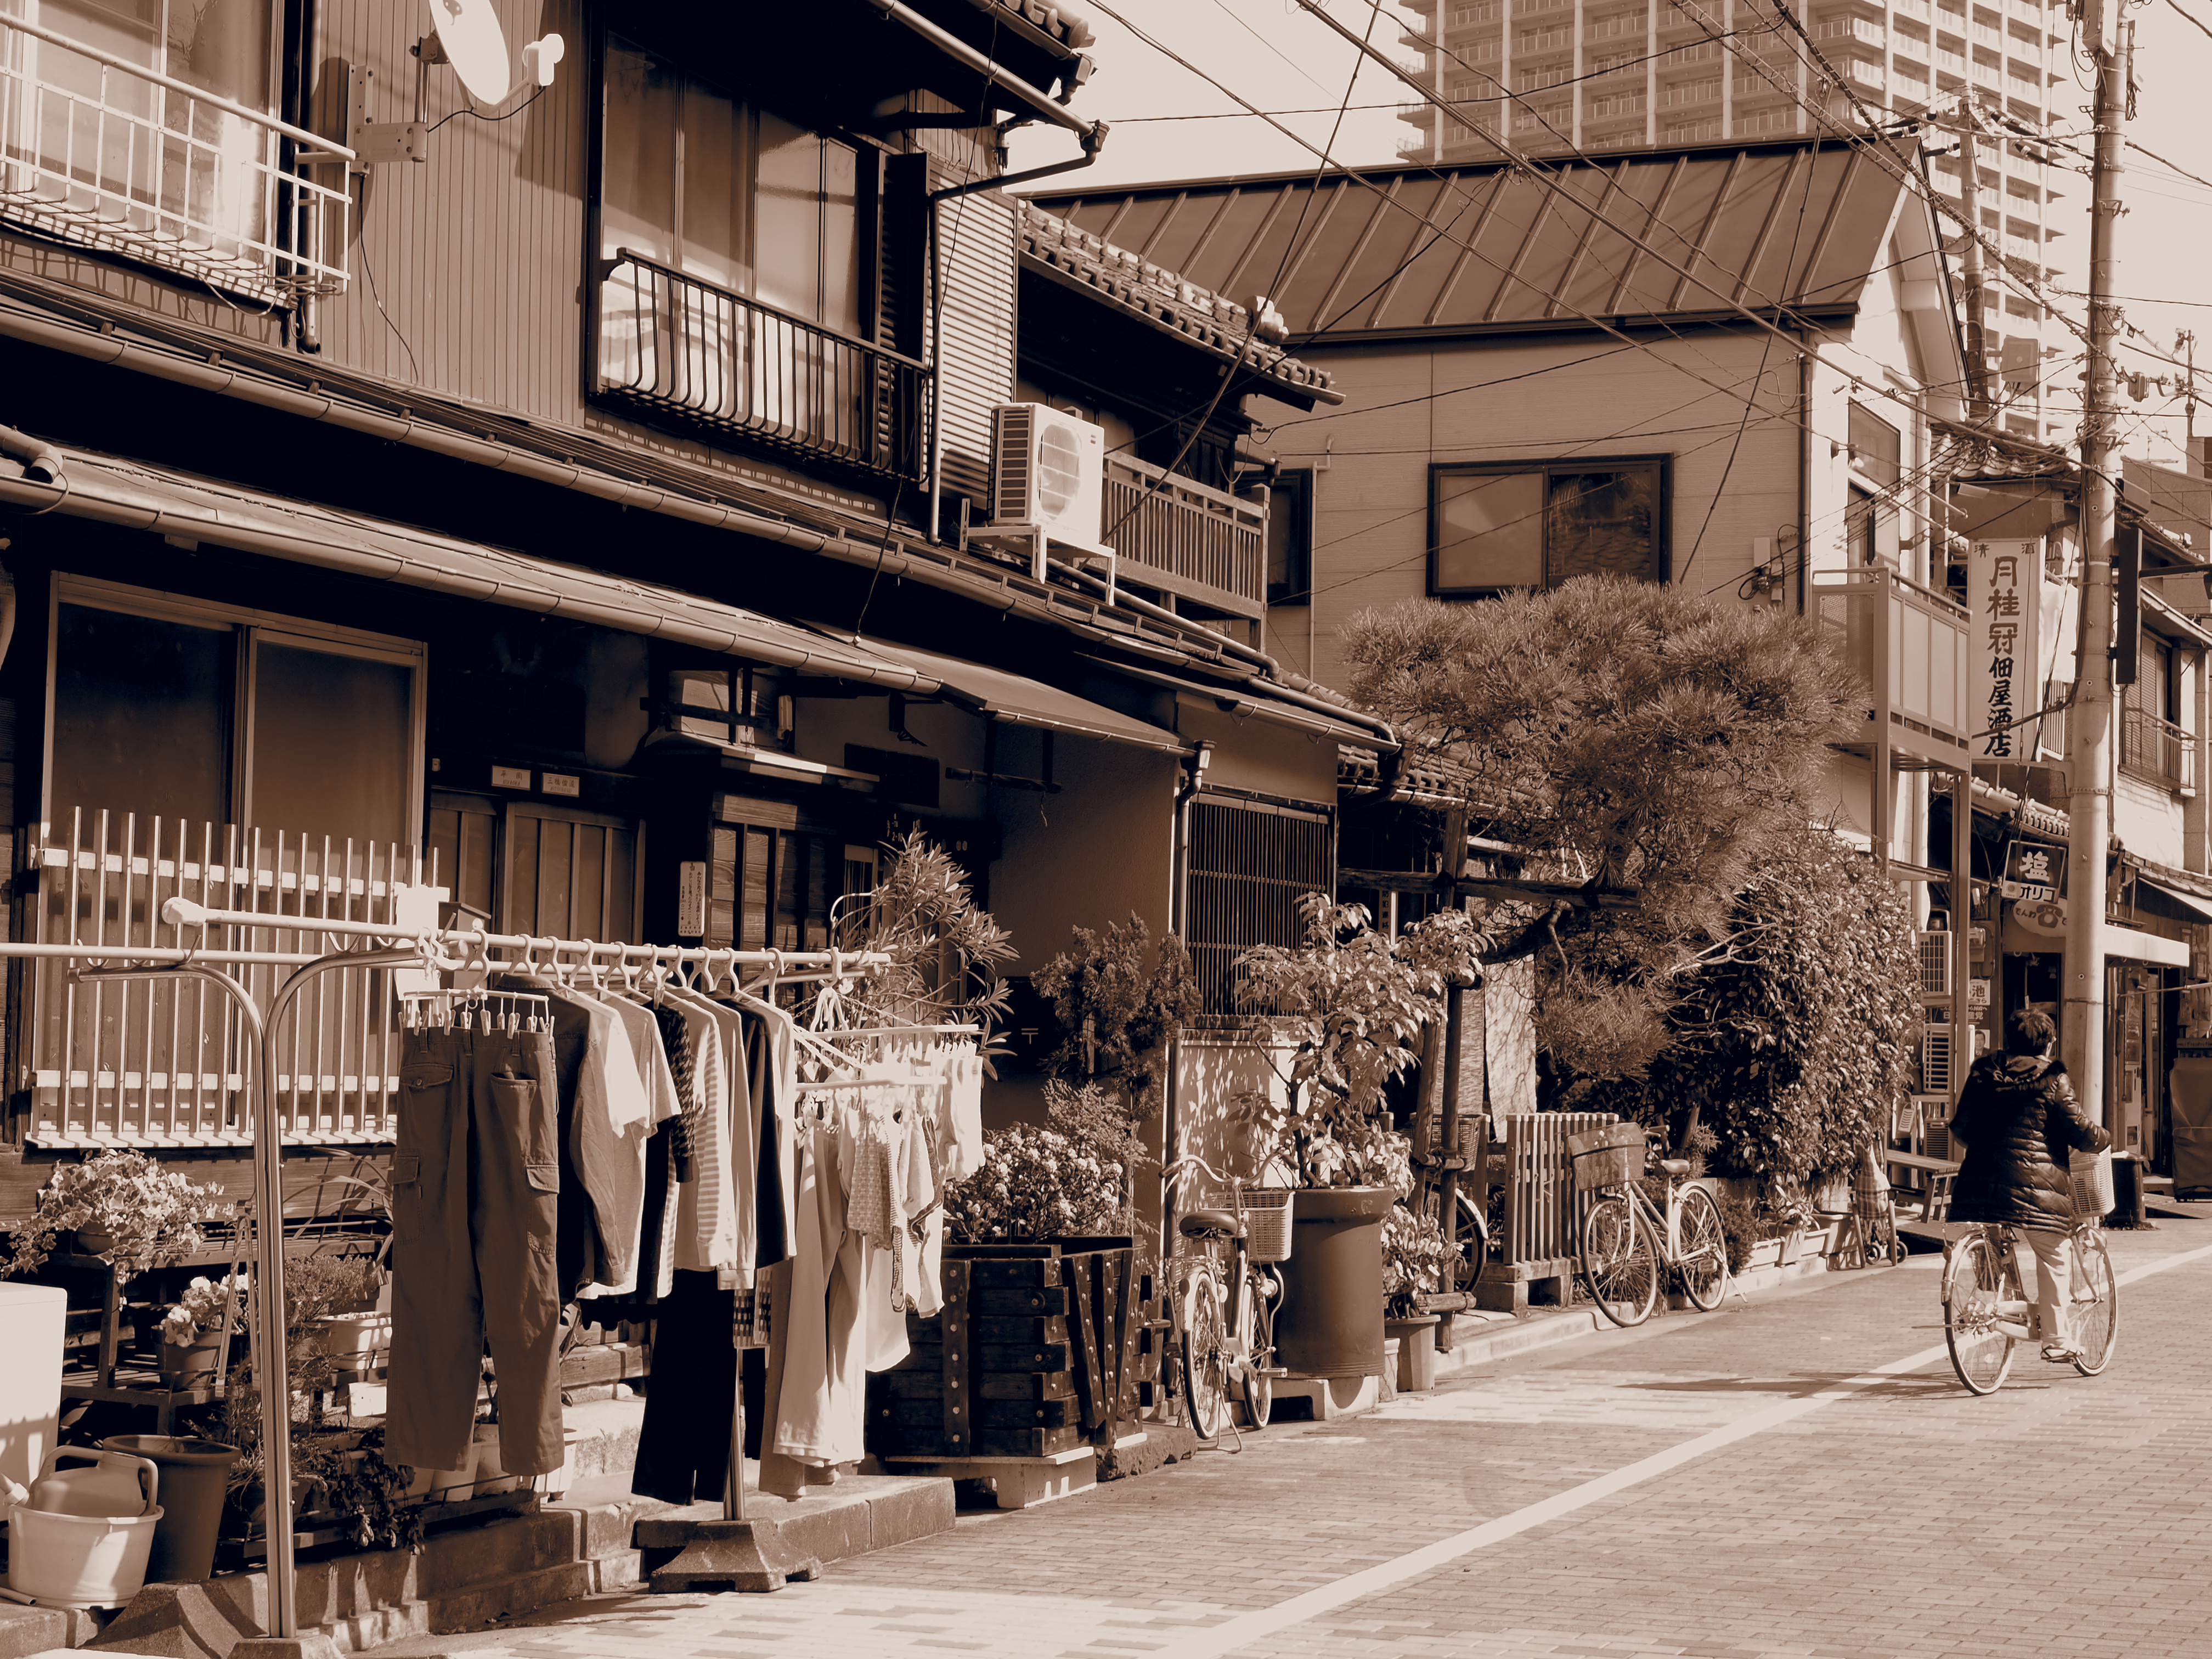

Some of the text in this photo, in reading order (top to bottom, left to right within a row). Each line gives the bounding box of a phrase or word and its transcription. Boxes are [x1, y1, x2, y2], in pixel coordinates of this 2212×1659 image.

[1985, 555, 2021, 656] 月桂冠
[1983, 656, 2015, 757] 佃屋酒店
[2018, 851, 2050, 882] 塩
[2019, 886, 2055, 903] オリコ
